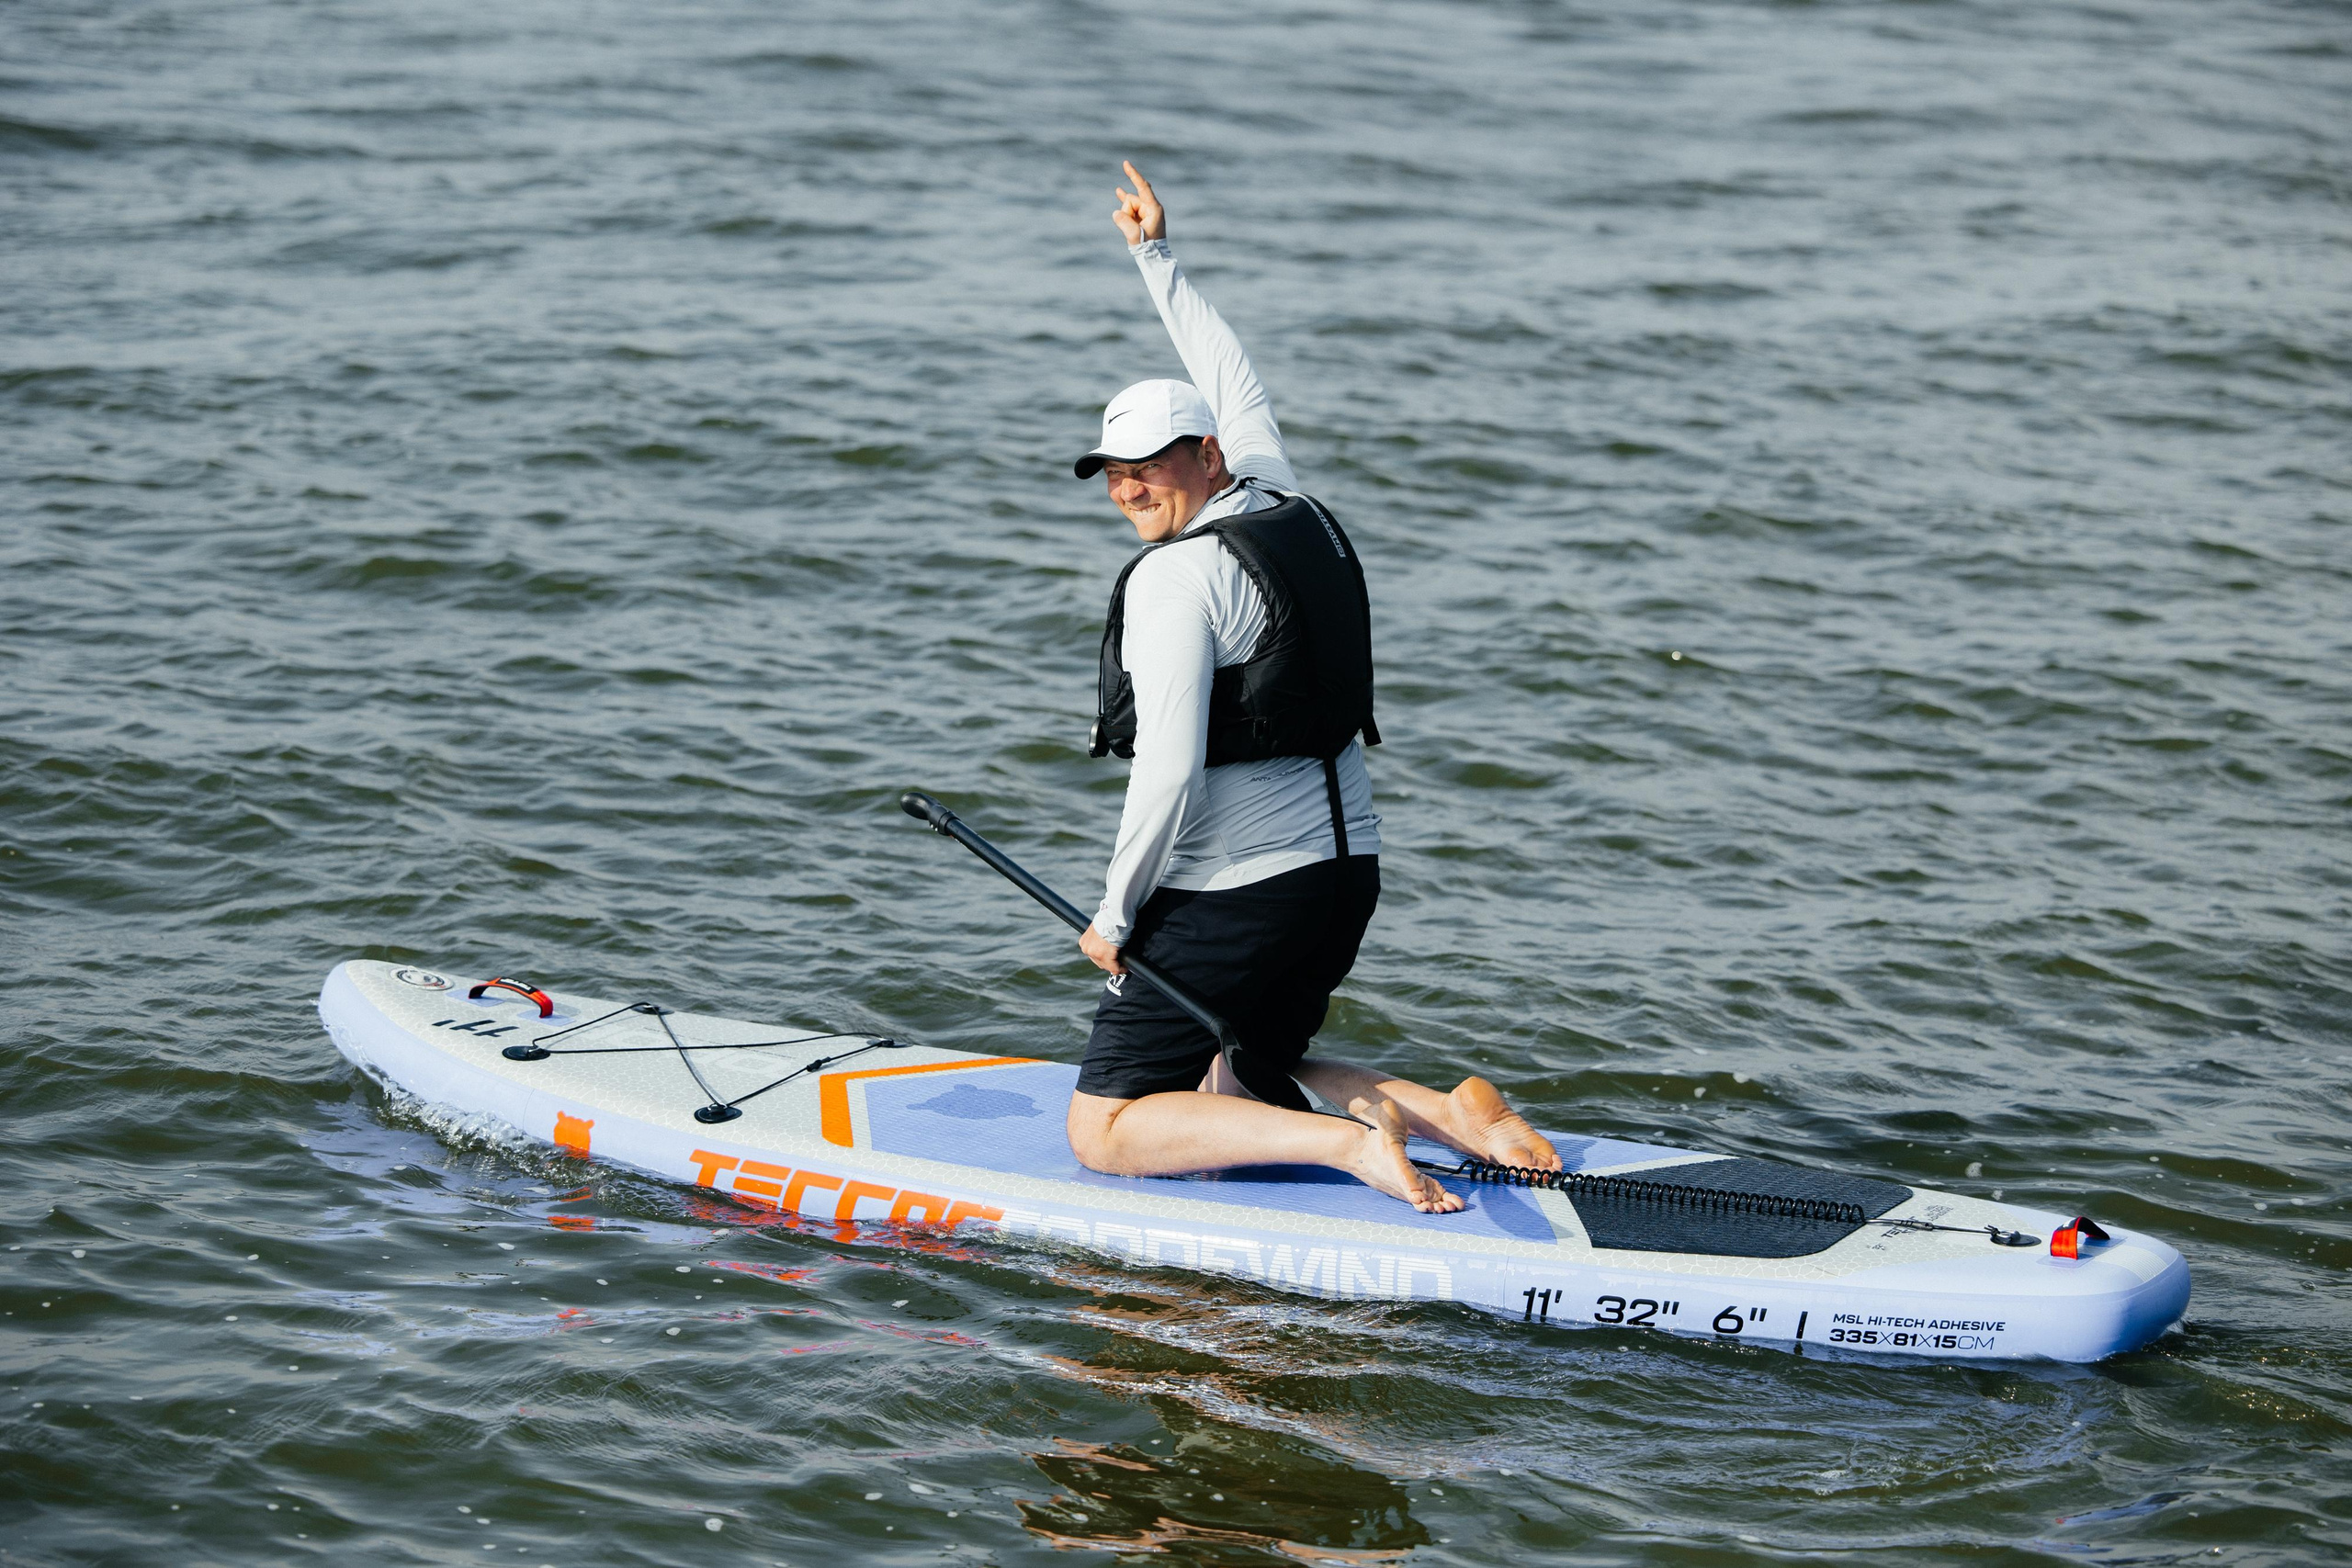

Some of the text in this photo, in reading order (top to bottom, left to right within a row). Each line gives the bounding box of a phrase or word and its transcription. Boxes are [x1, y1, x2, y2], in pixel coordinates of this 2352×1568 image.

[1833, 1314, 2006, 1332] MSL HI-TECH ADHESIVE
